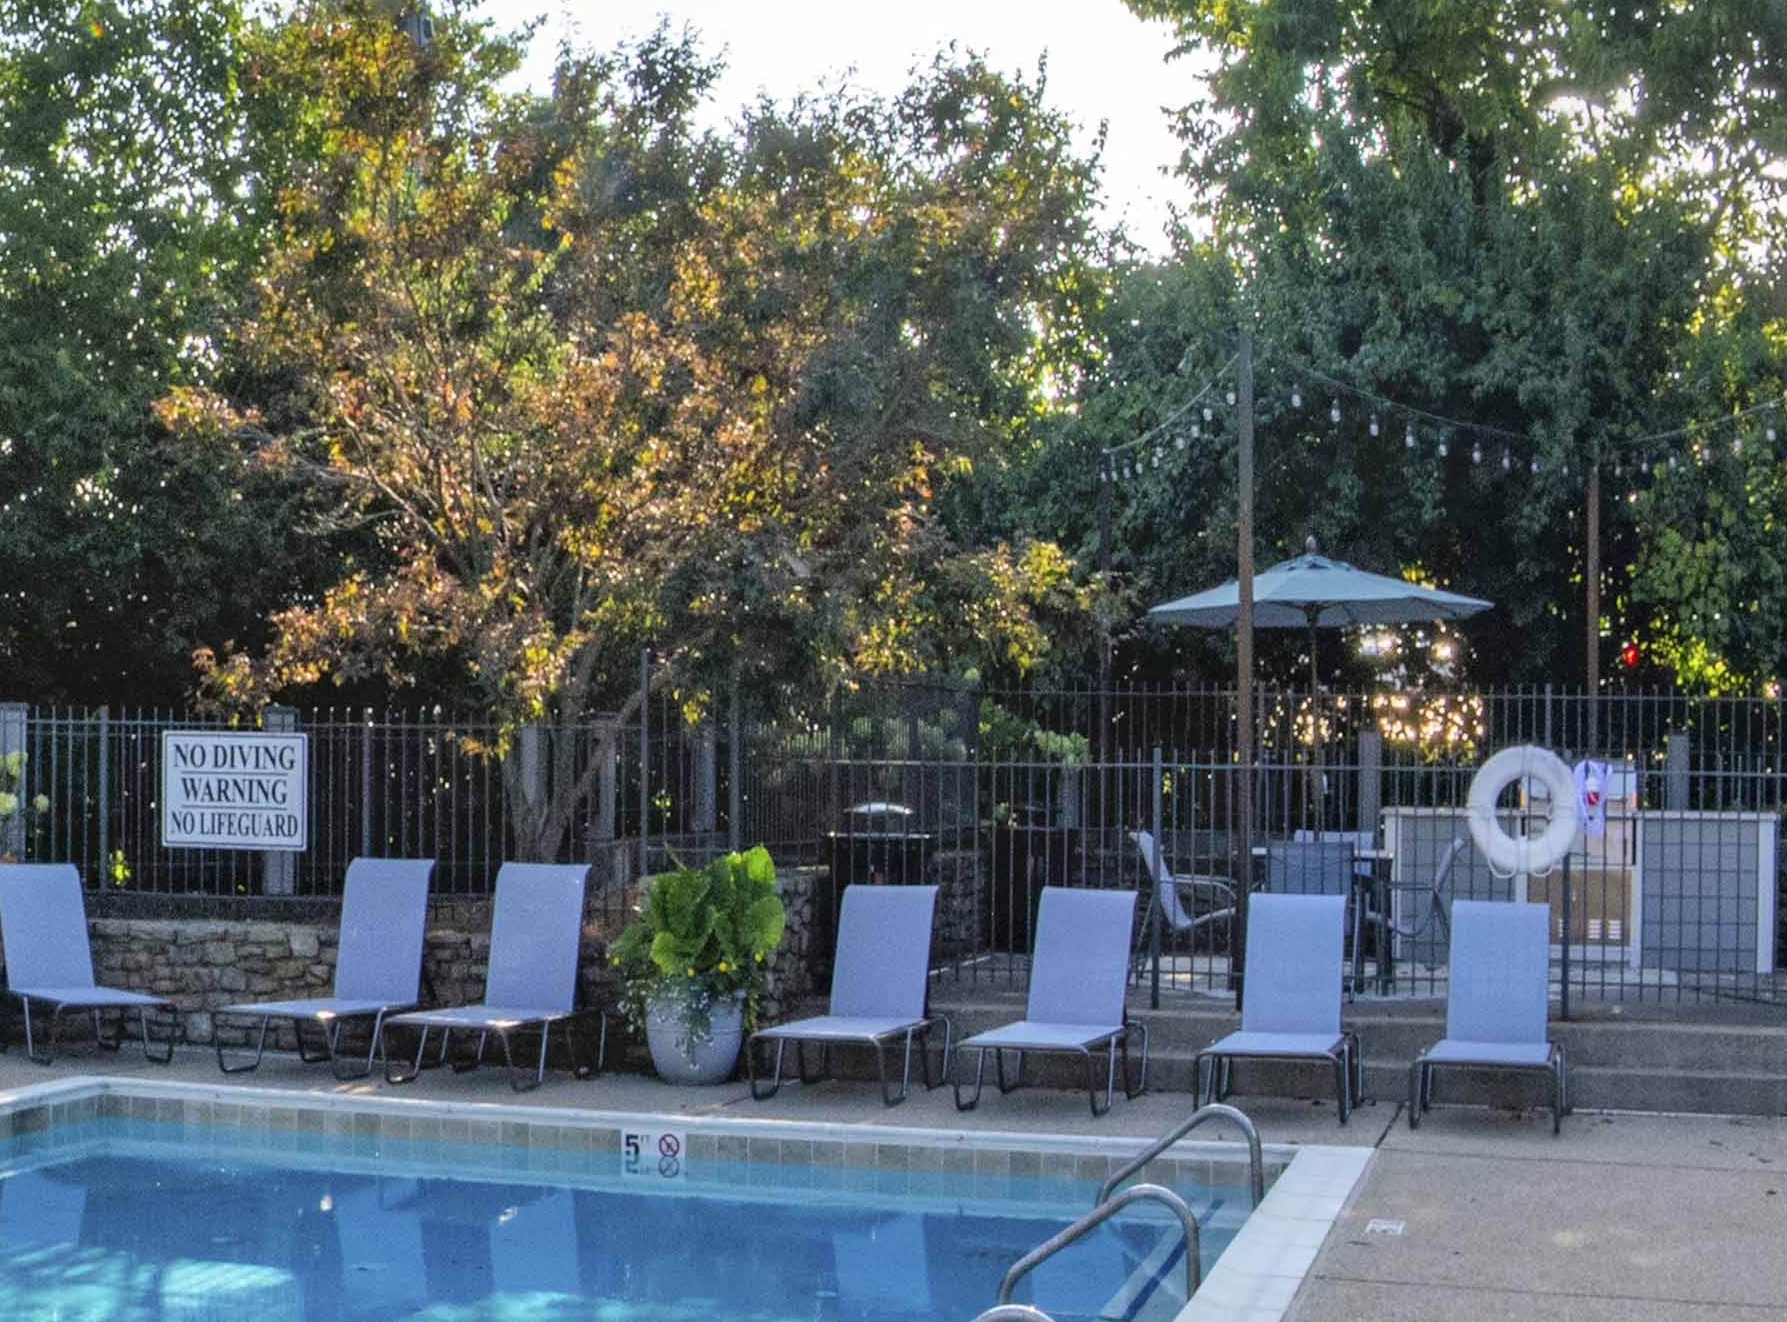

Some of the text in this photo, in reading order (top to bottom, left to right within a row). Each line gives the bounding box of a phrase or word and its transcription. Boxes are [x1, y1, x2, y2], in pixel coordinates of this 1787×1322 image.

[174, 744, 295, 771] NO DIVING
[182, 777, 287, 805] WARNING
[171, 811, 298, 838] NO LIFEGUARD
[625, 1134, 640, 1156] 5
